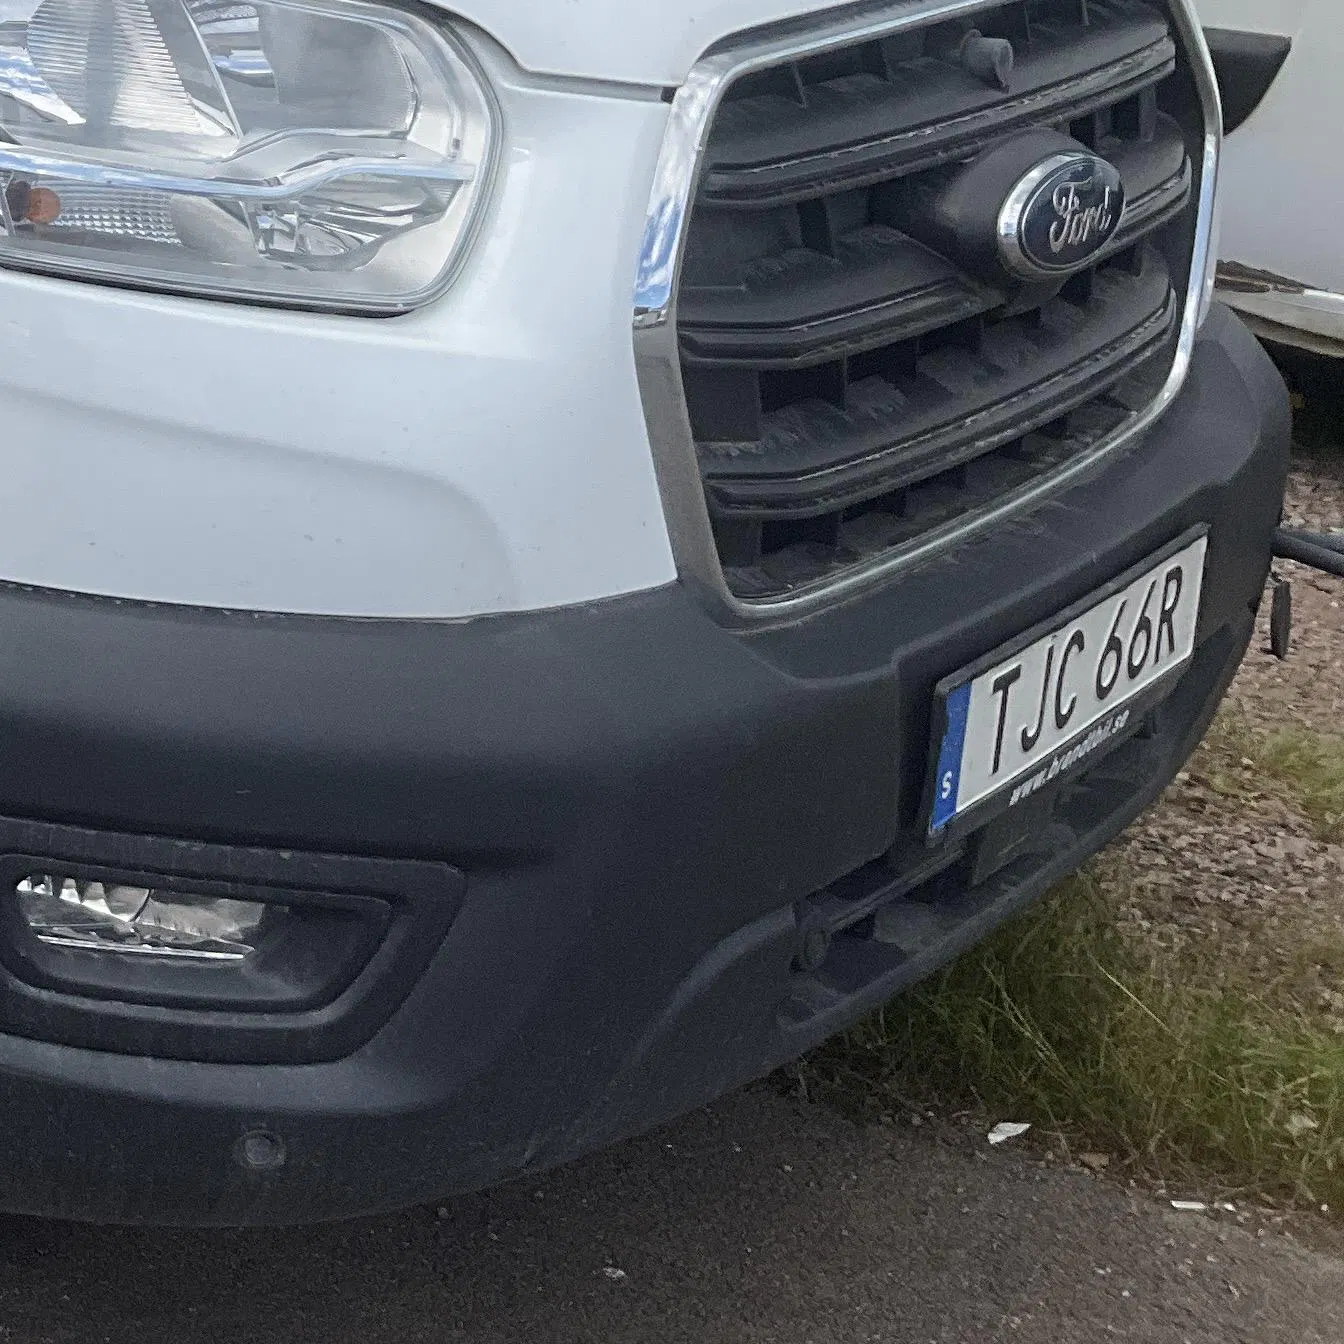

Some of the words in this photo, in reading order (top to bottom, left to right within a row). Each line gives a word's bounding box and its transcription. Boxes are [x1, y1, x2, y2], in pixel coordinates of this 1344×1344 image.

[1049, 176, 1112, 254] Ford
[989, 628, 1085, 776] TJC
[1095, 564, 1183, 701] 66R
[941, 771, 953, 799] S
